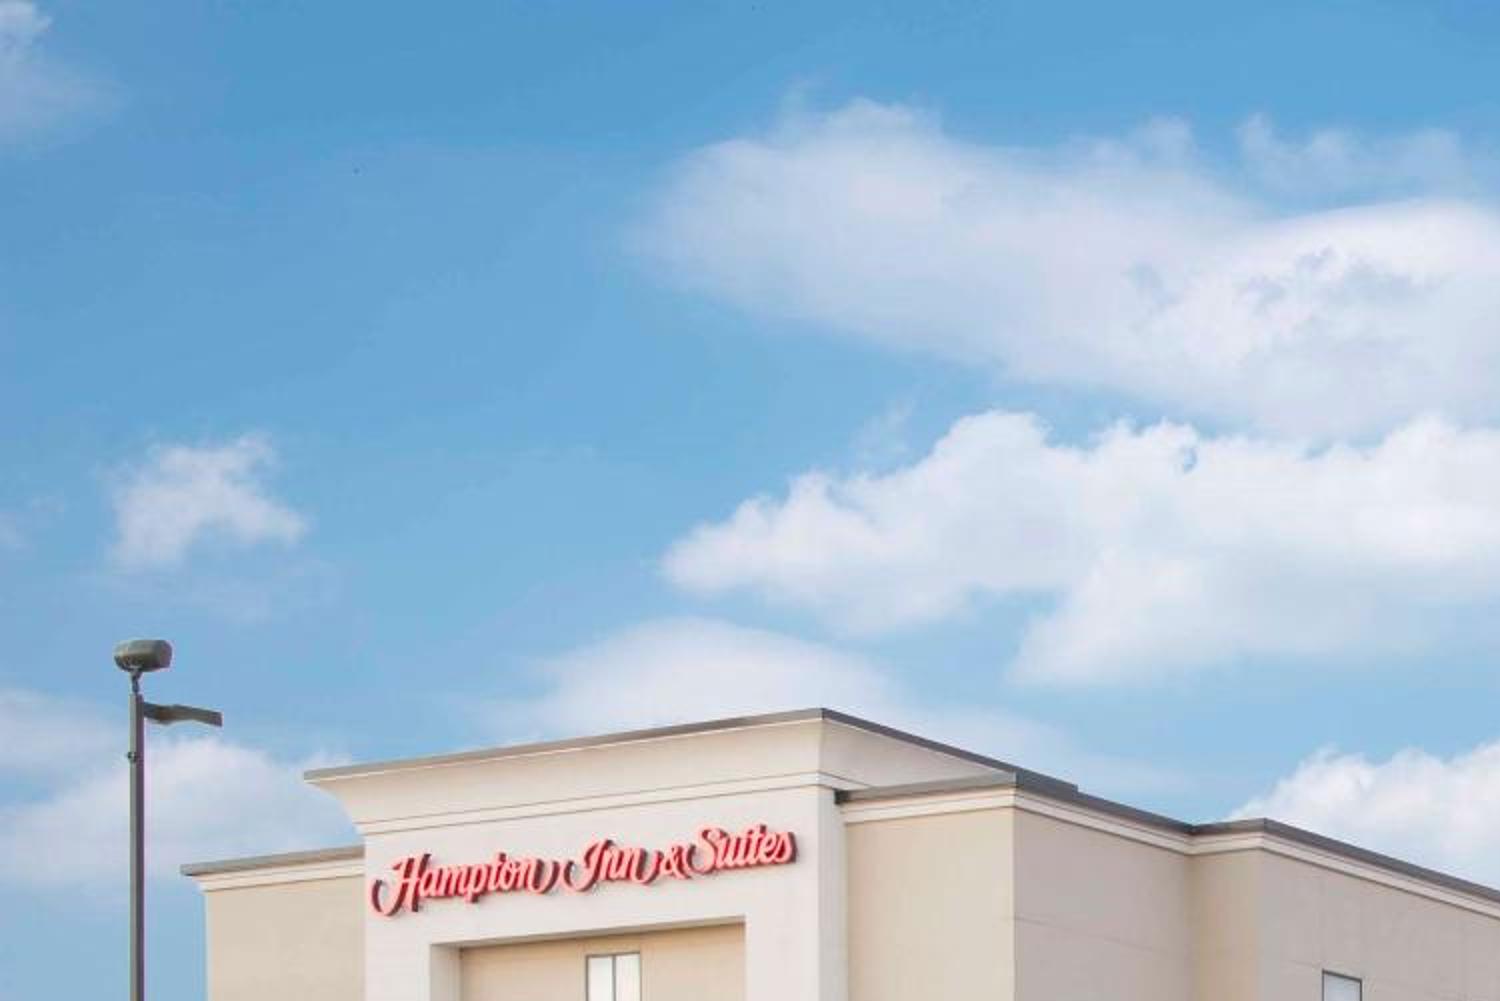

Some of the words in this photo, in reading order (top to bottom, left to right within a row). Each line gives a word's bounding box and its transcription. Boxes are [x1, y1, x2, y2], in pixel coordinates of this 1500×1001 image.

[369, 851, 562, 919] Hampton
[561, 838, 665, 894] Inn
[658, 844, 692, 880] &
[687, 823, 799, 876] Suites
